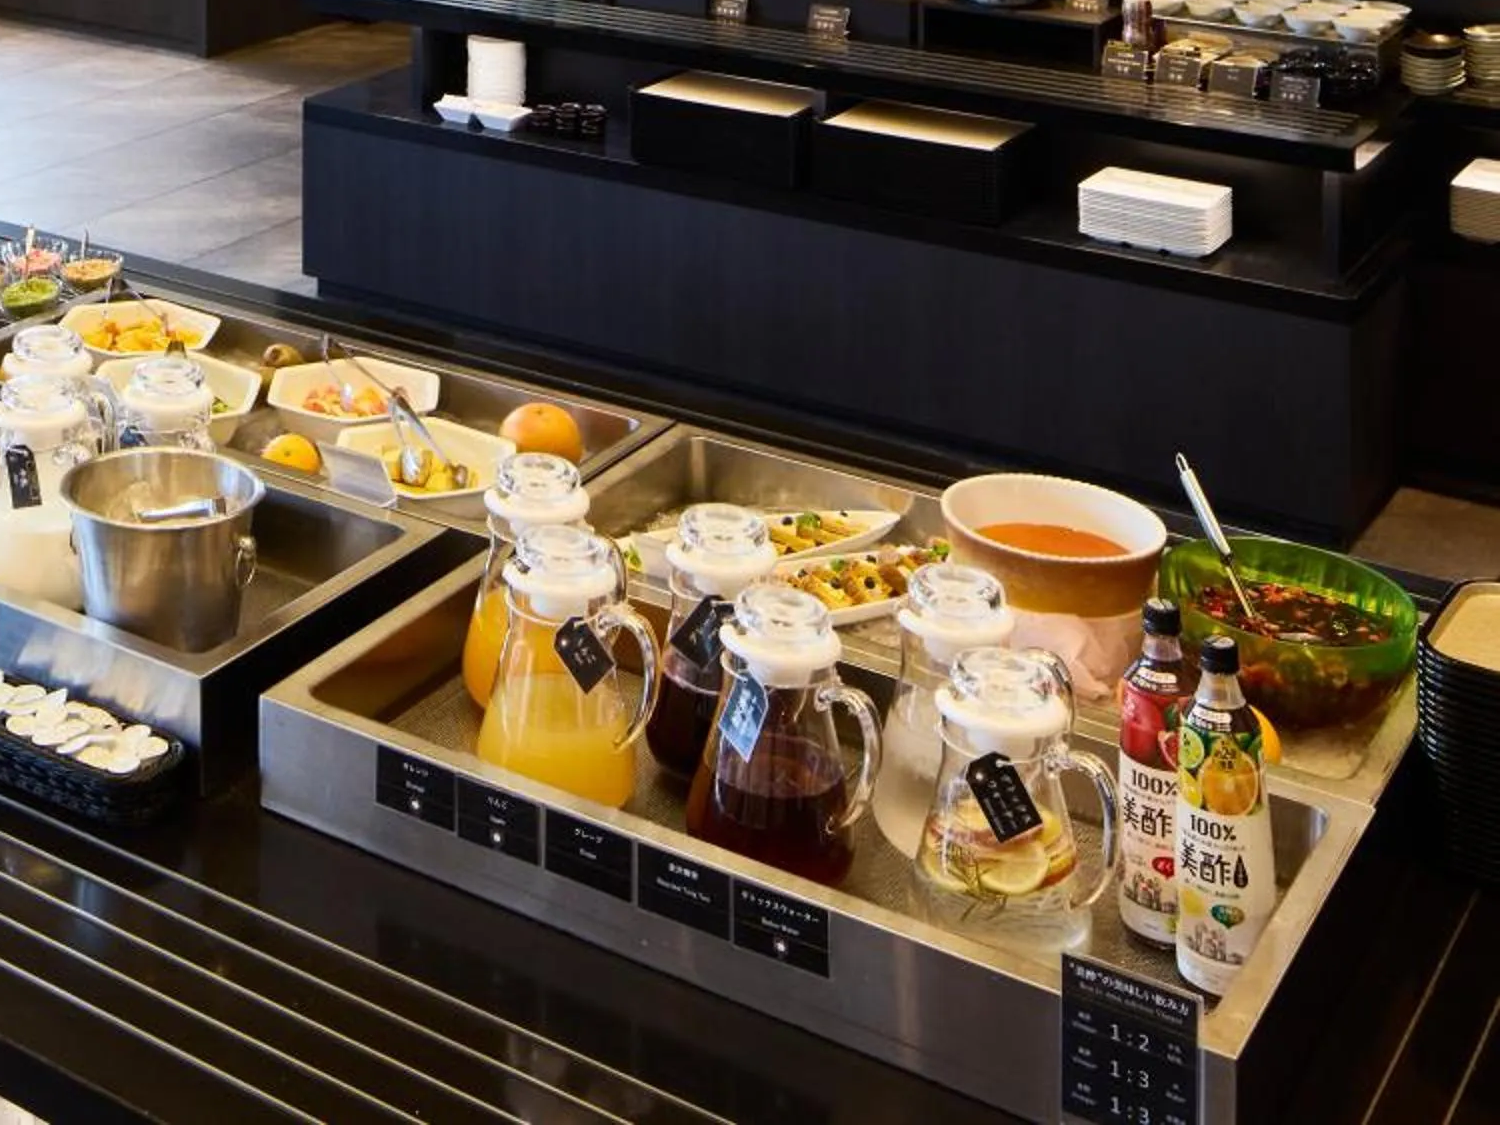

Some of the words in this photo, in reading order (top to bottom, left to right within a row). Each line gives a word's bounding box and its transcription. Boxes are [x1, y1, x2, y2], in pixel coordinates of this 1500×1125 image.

[1132, 769, 1178, 797] 100%
[1190, 813, 1237, 842] 100%
[1181, 837, 1232, 888] 美酢
